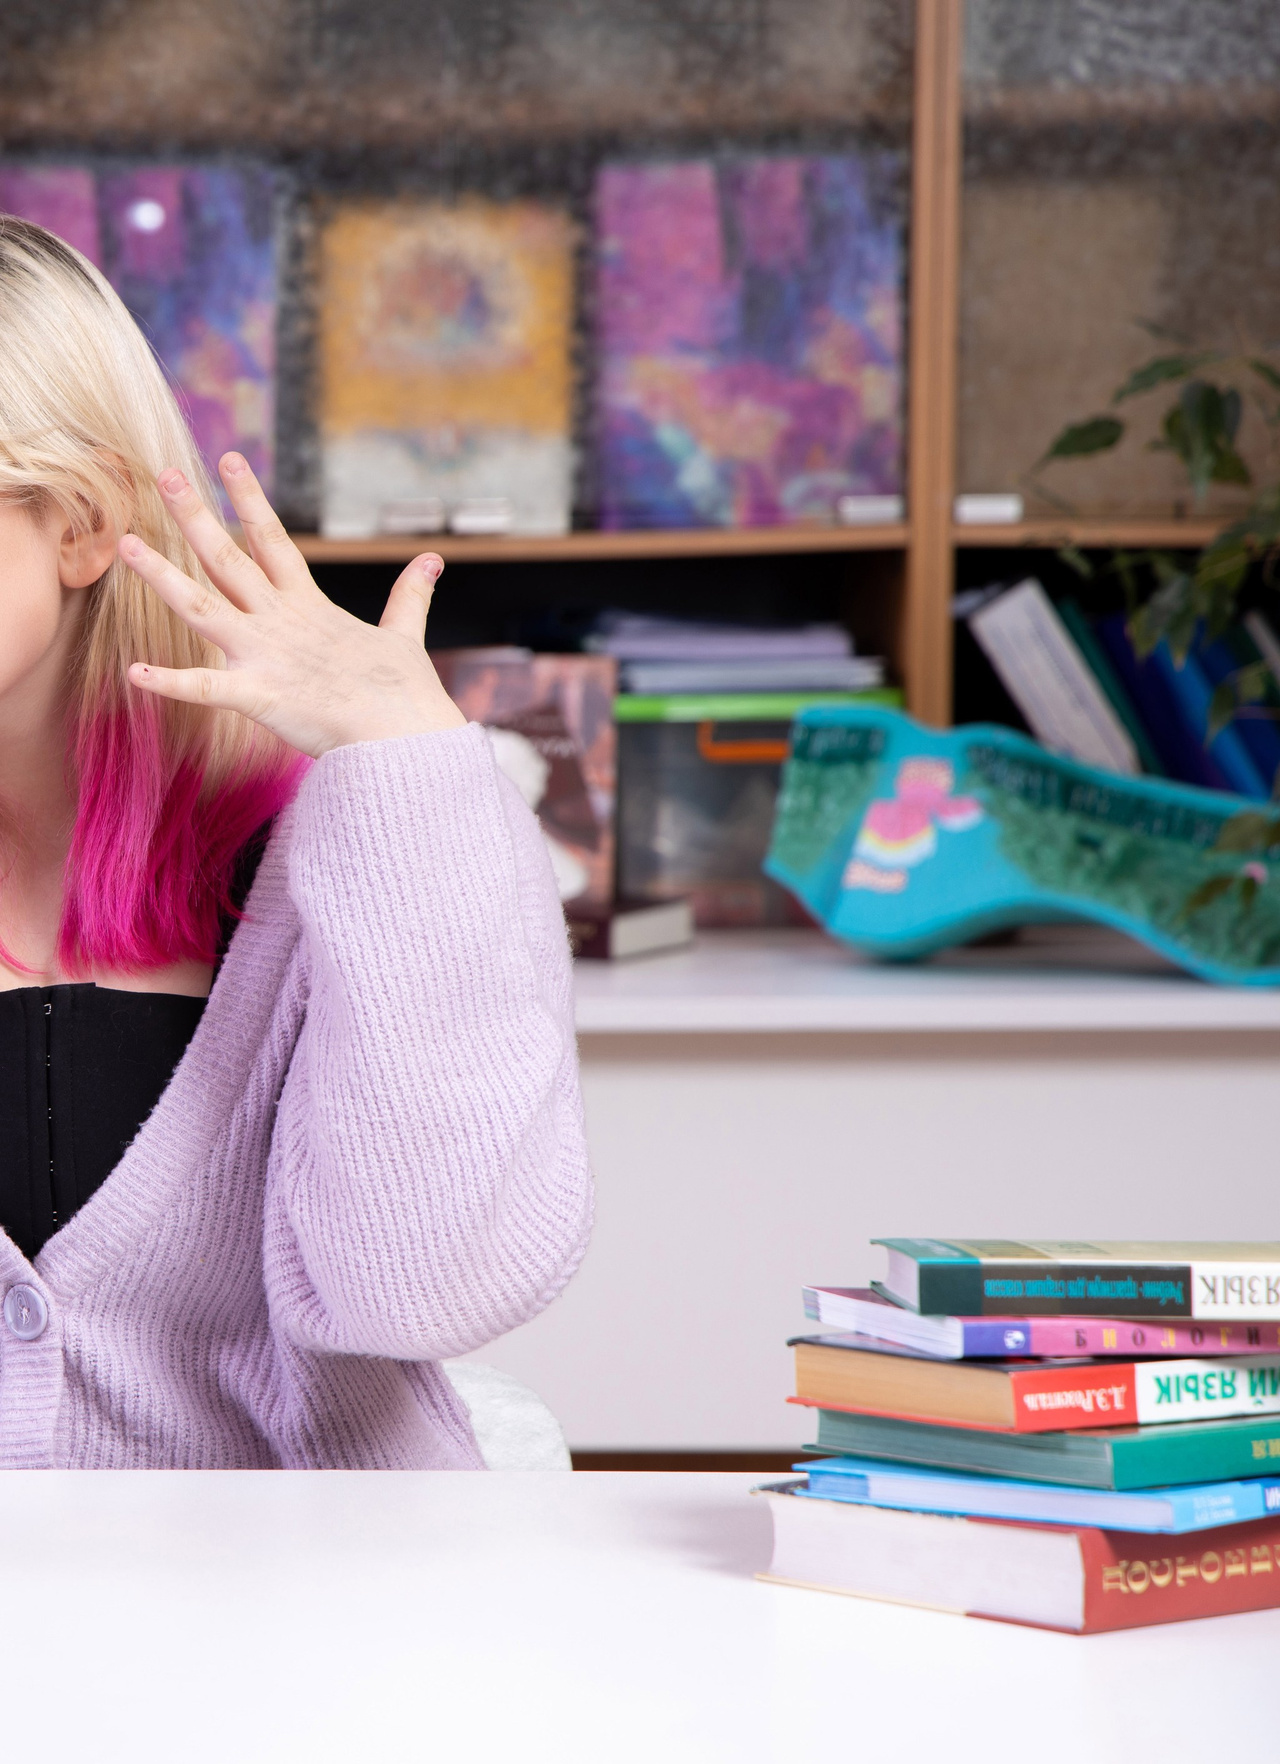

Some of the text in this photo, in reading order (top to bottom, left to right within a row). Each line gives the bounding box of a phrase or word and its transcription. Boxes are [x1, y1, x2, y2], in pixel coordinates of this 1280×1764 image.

[1074, 1326, 1280, 1349] БИОЛОГИ
[1154, 1369, 1237, 1405] ЯЗЫК
[1102, 1544, 1280, 1594] ДОСТОЕВ
